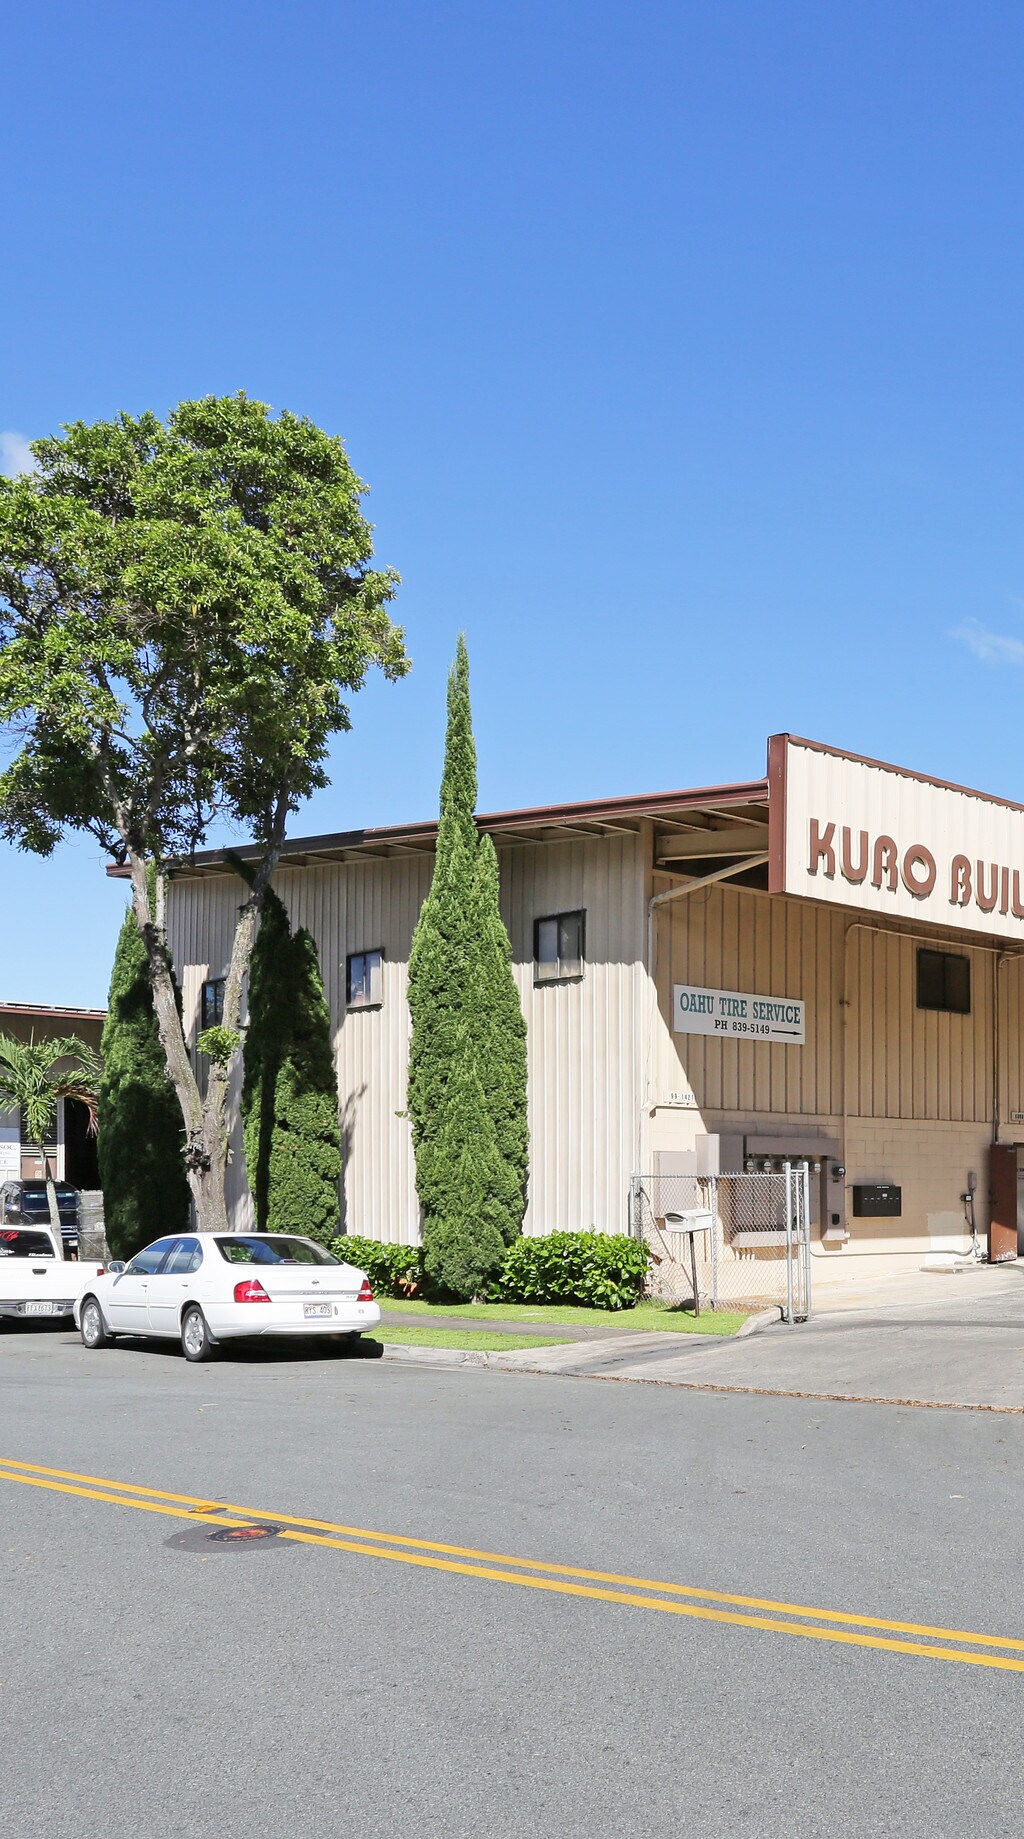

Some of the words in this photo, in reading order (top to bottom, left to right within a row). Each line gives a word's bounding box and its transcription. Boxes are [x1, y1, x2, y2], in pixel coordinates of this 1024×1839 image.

[807, 818, 937, 899] KURO
[680, 992, 714, 1014] OAHU
[719, 997, 747, 1018] TIRE
[753, 1001, 800, 1024] SERVICE
[714, 1019, 728, 1030] PH
[732, 1021, 770, 1034] 839-5149
